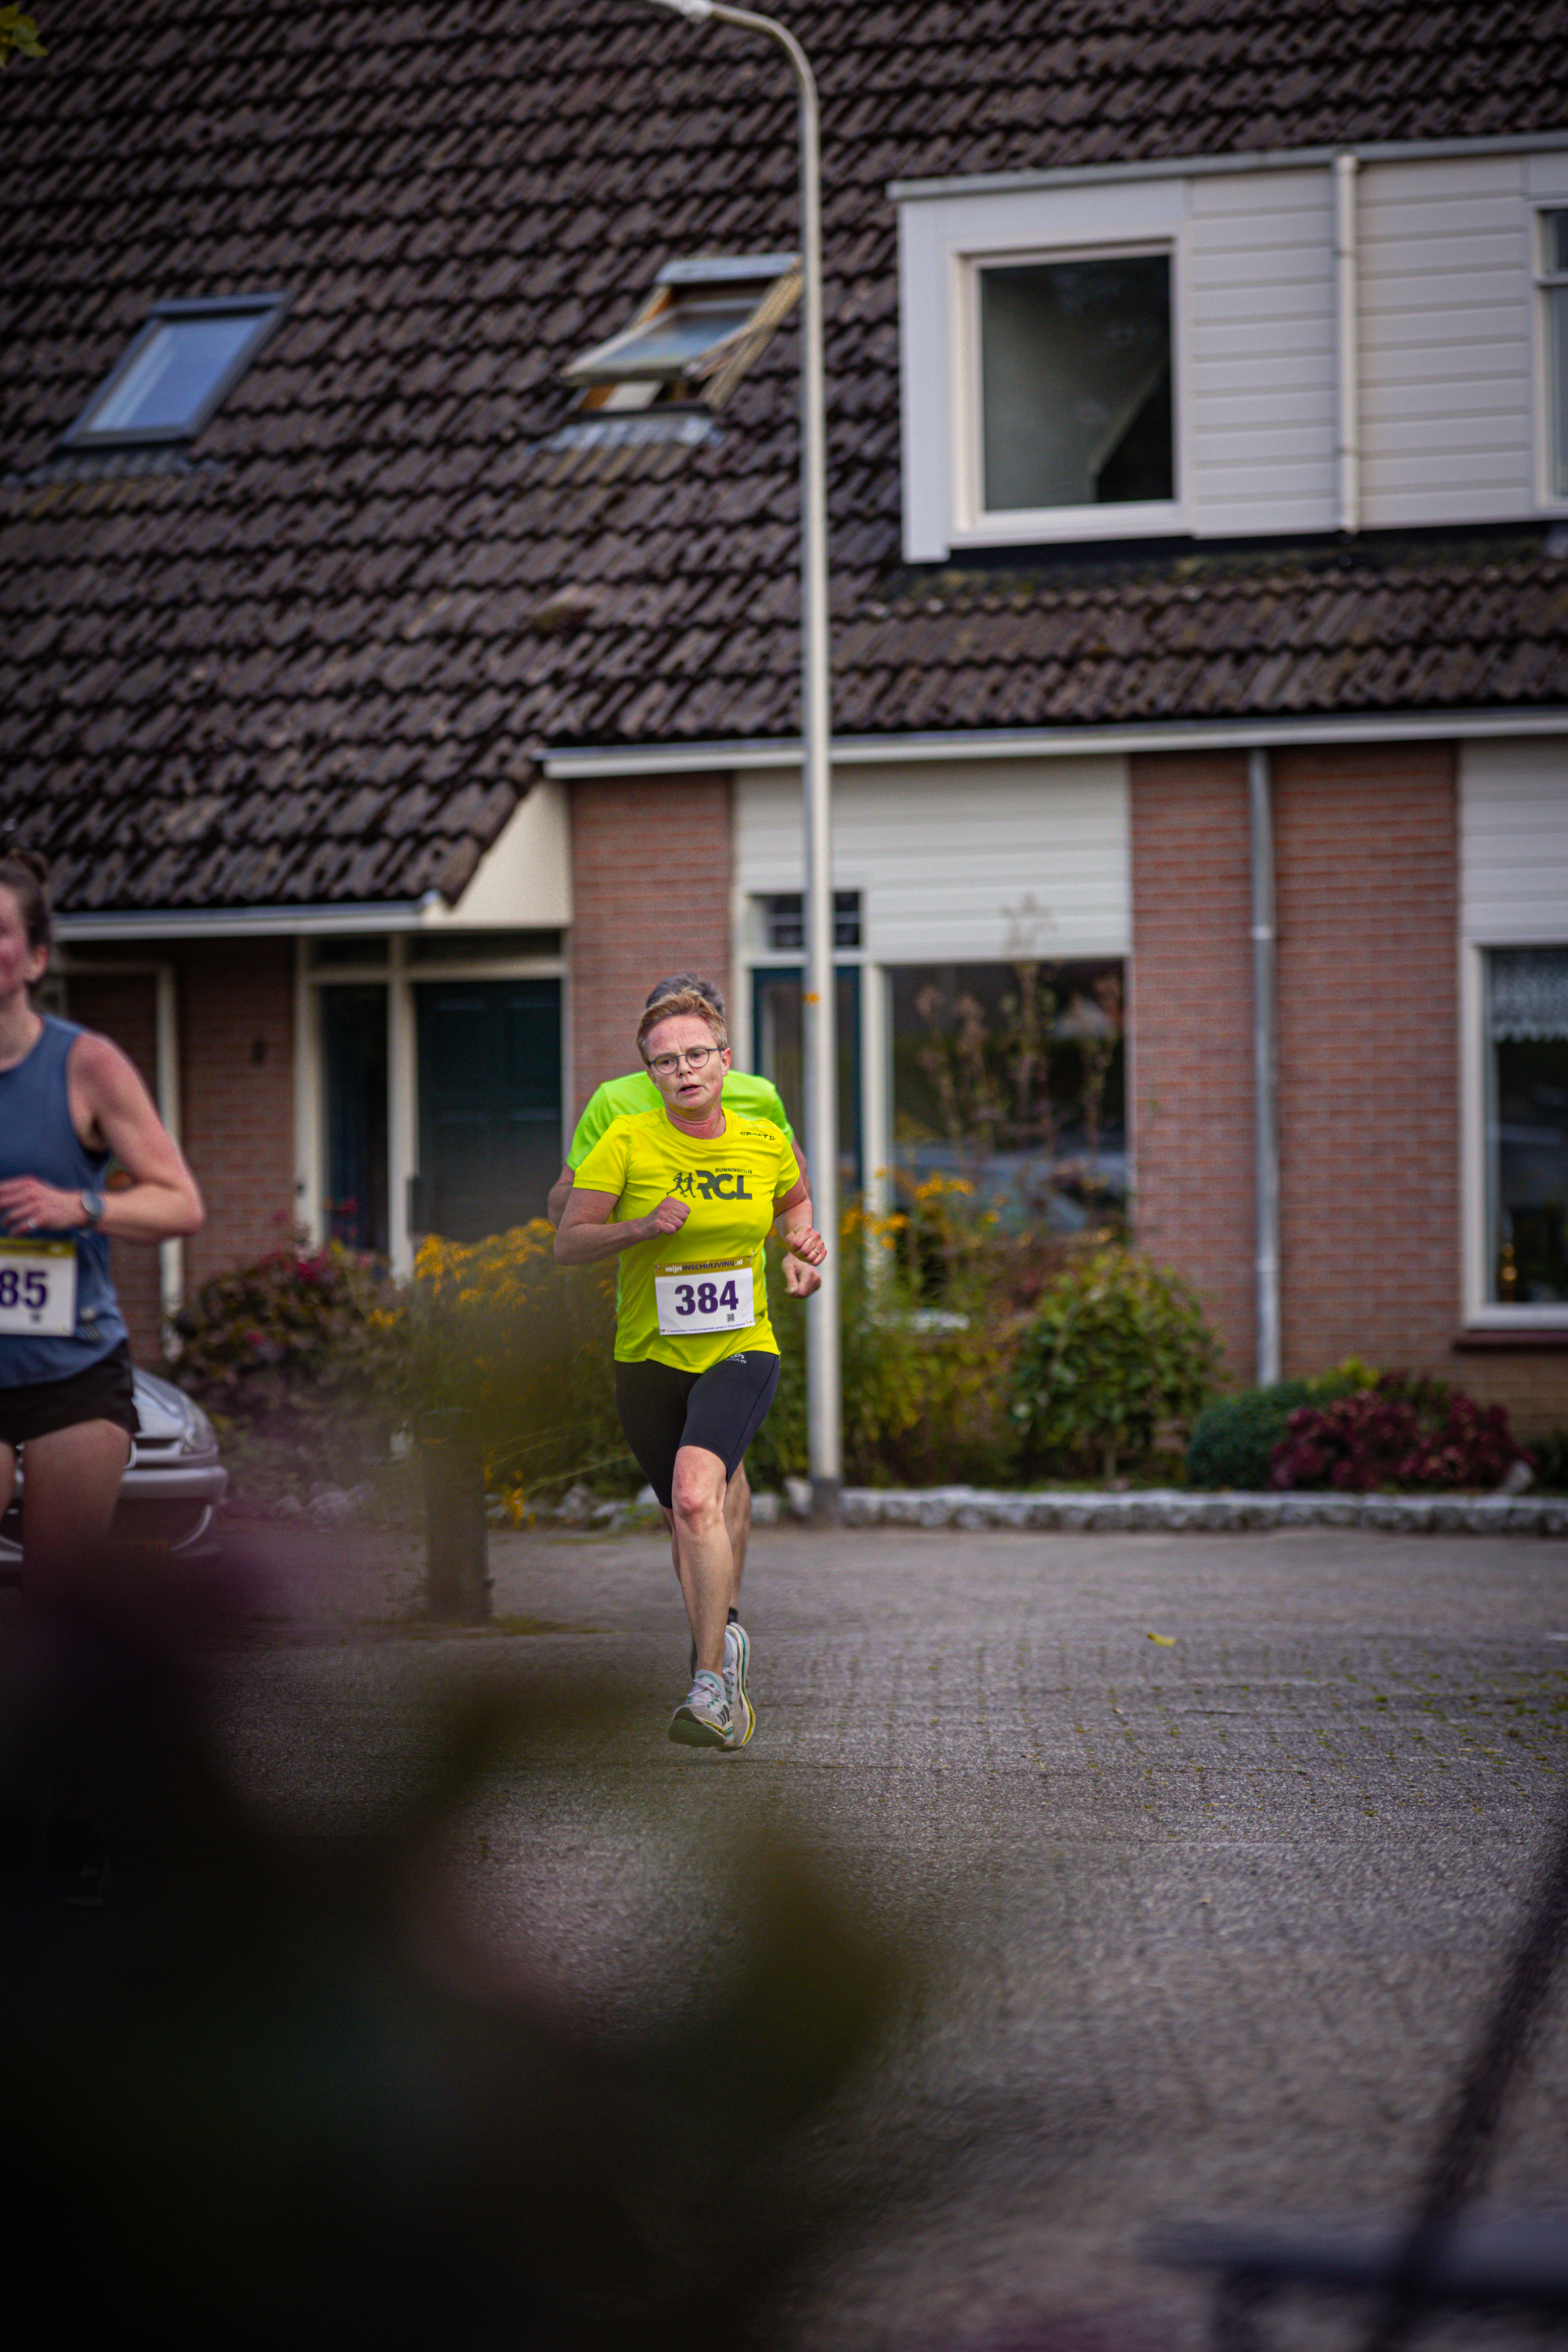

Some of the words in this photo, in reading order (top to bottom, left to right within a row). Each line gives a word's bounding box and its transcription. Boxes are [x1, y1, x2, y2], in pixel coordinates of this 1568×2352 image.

[695, 1170, 753, 1200] RCL
[0, 1269, 47, 1308] 85
[674, 1280, 739, 1316] 384
